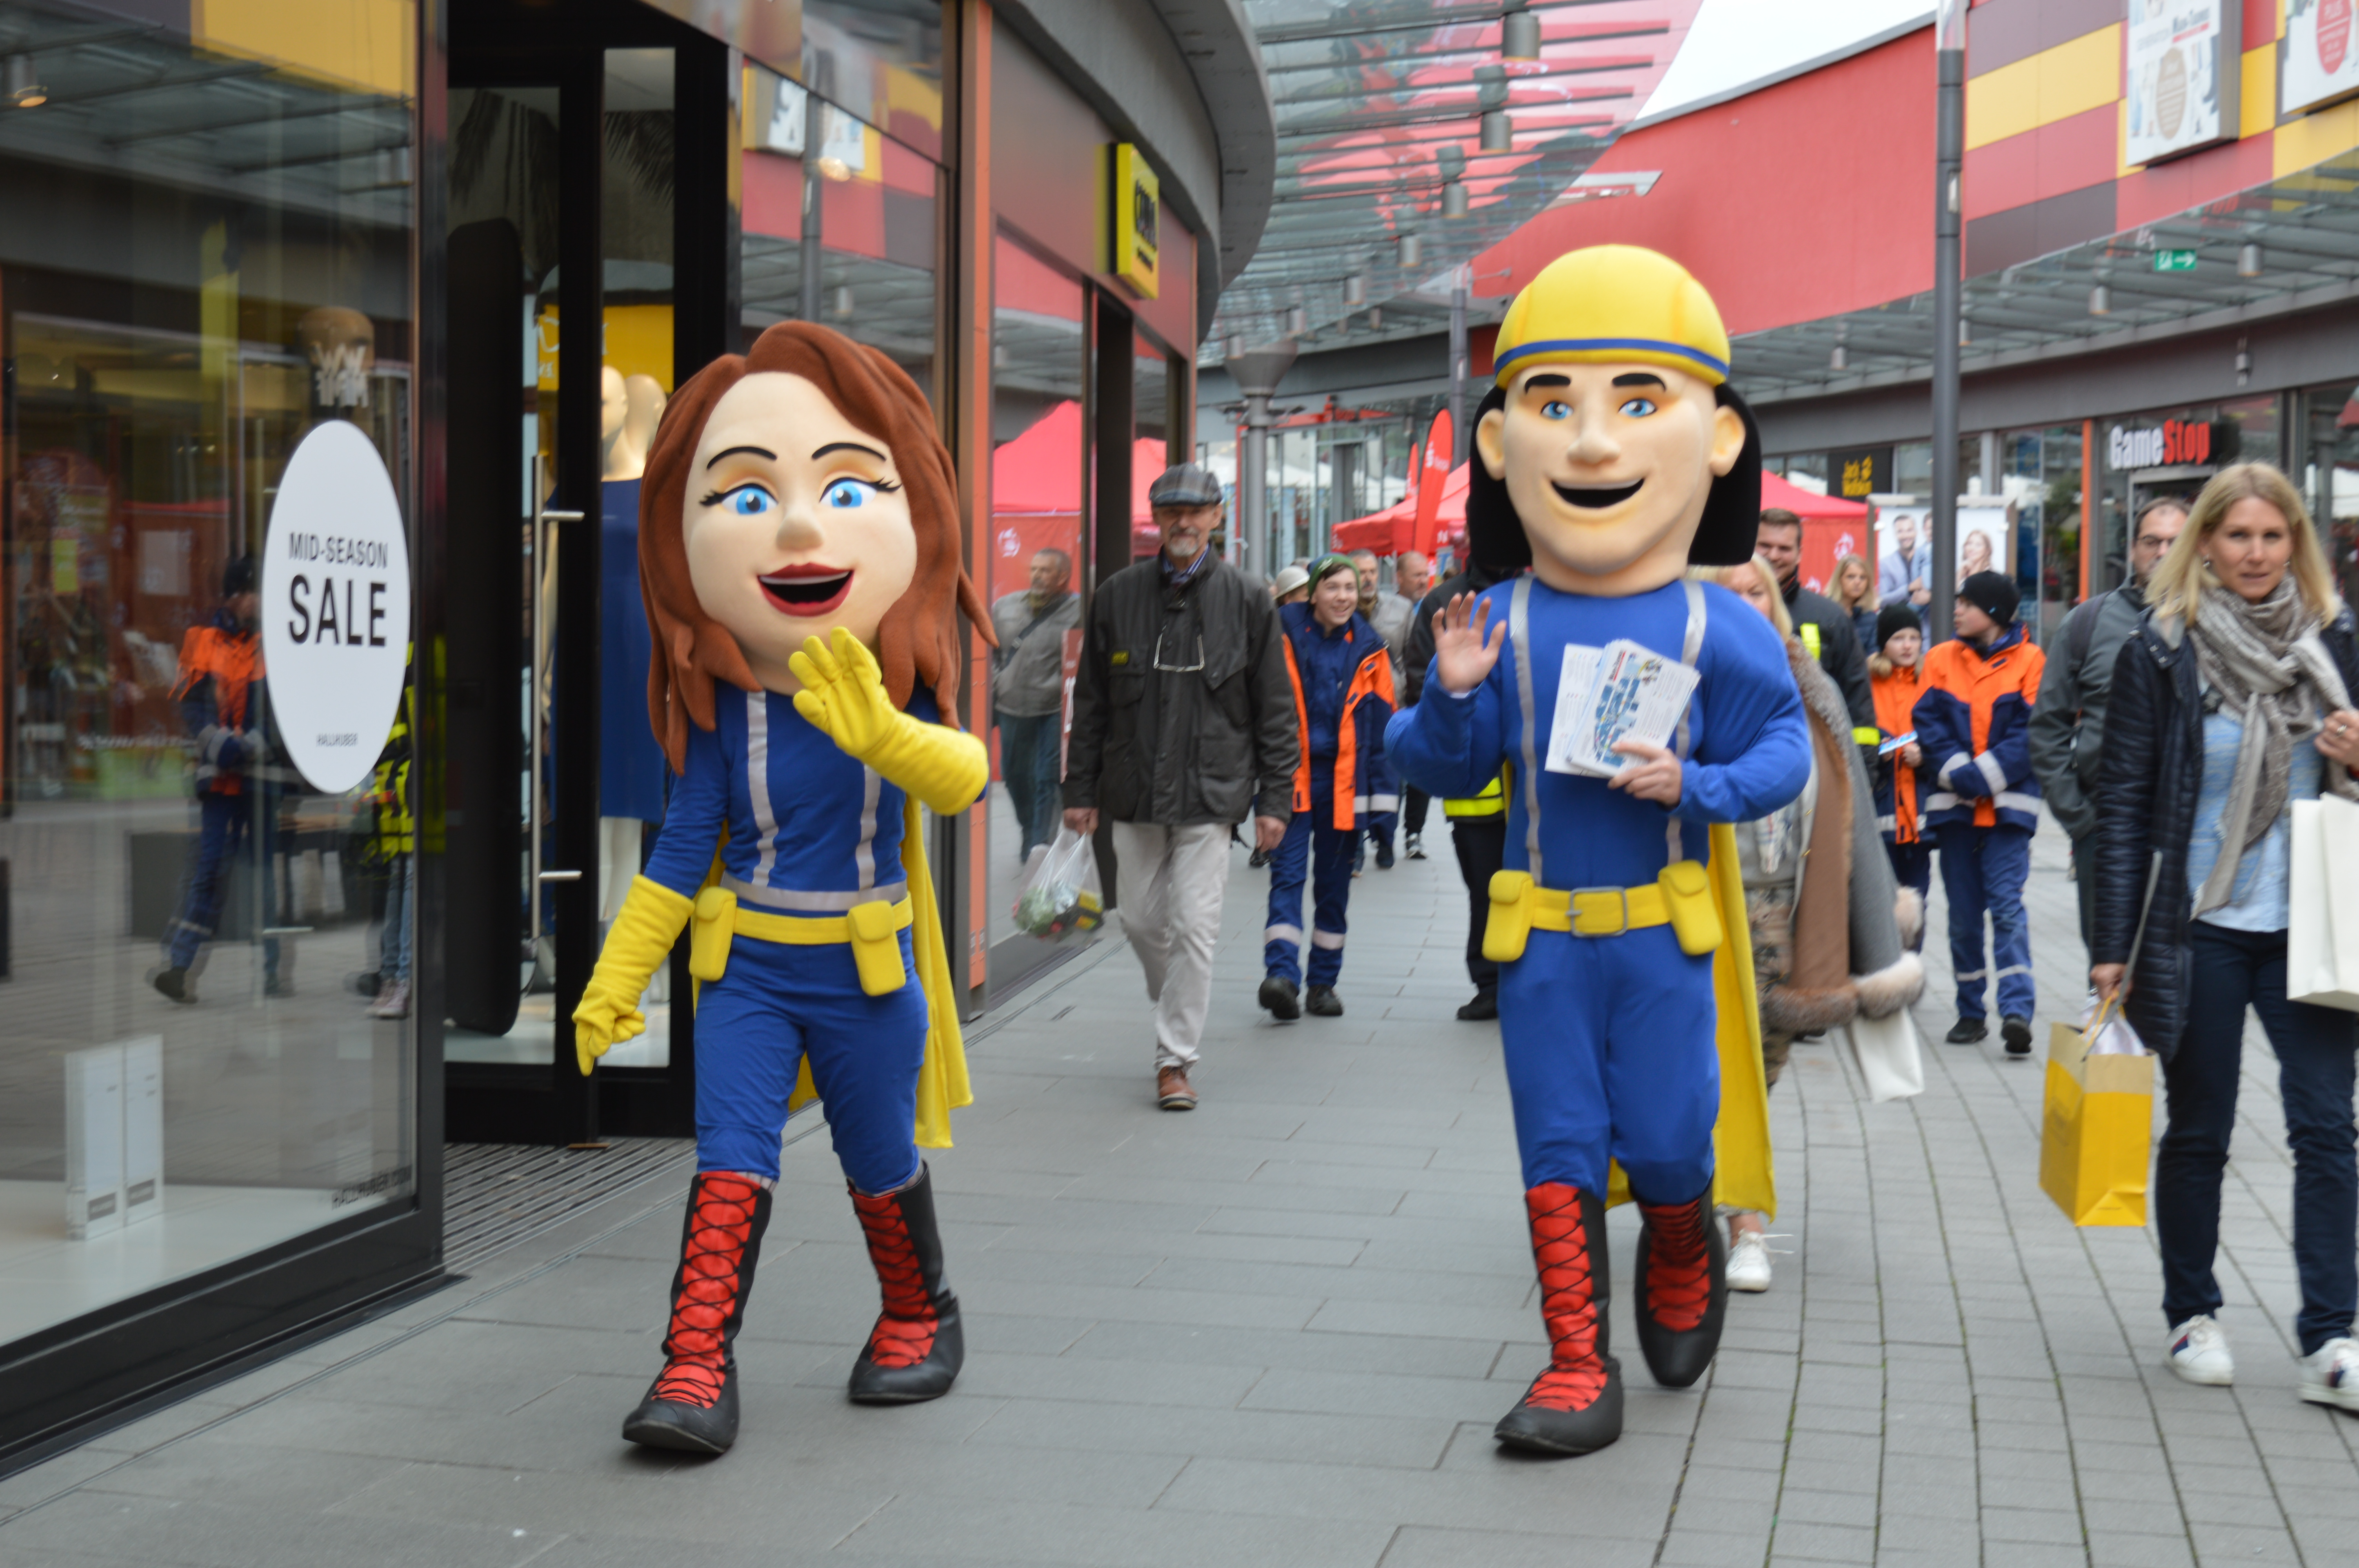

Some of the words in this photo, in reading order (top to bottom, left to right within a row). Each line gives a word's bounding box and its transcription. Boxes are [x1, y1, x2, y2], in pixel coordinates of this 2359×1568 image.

[2110, 418, 2210, 470] GameStop
[289, 532, 388, 568] MID-SEASON
[288, 573, 387, 647] SALE
[316, 732, 358, 746] HALLHUBER
